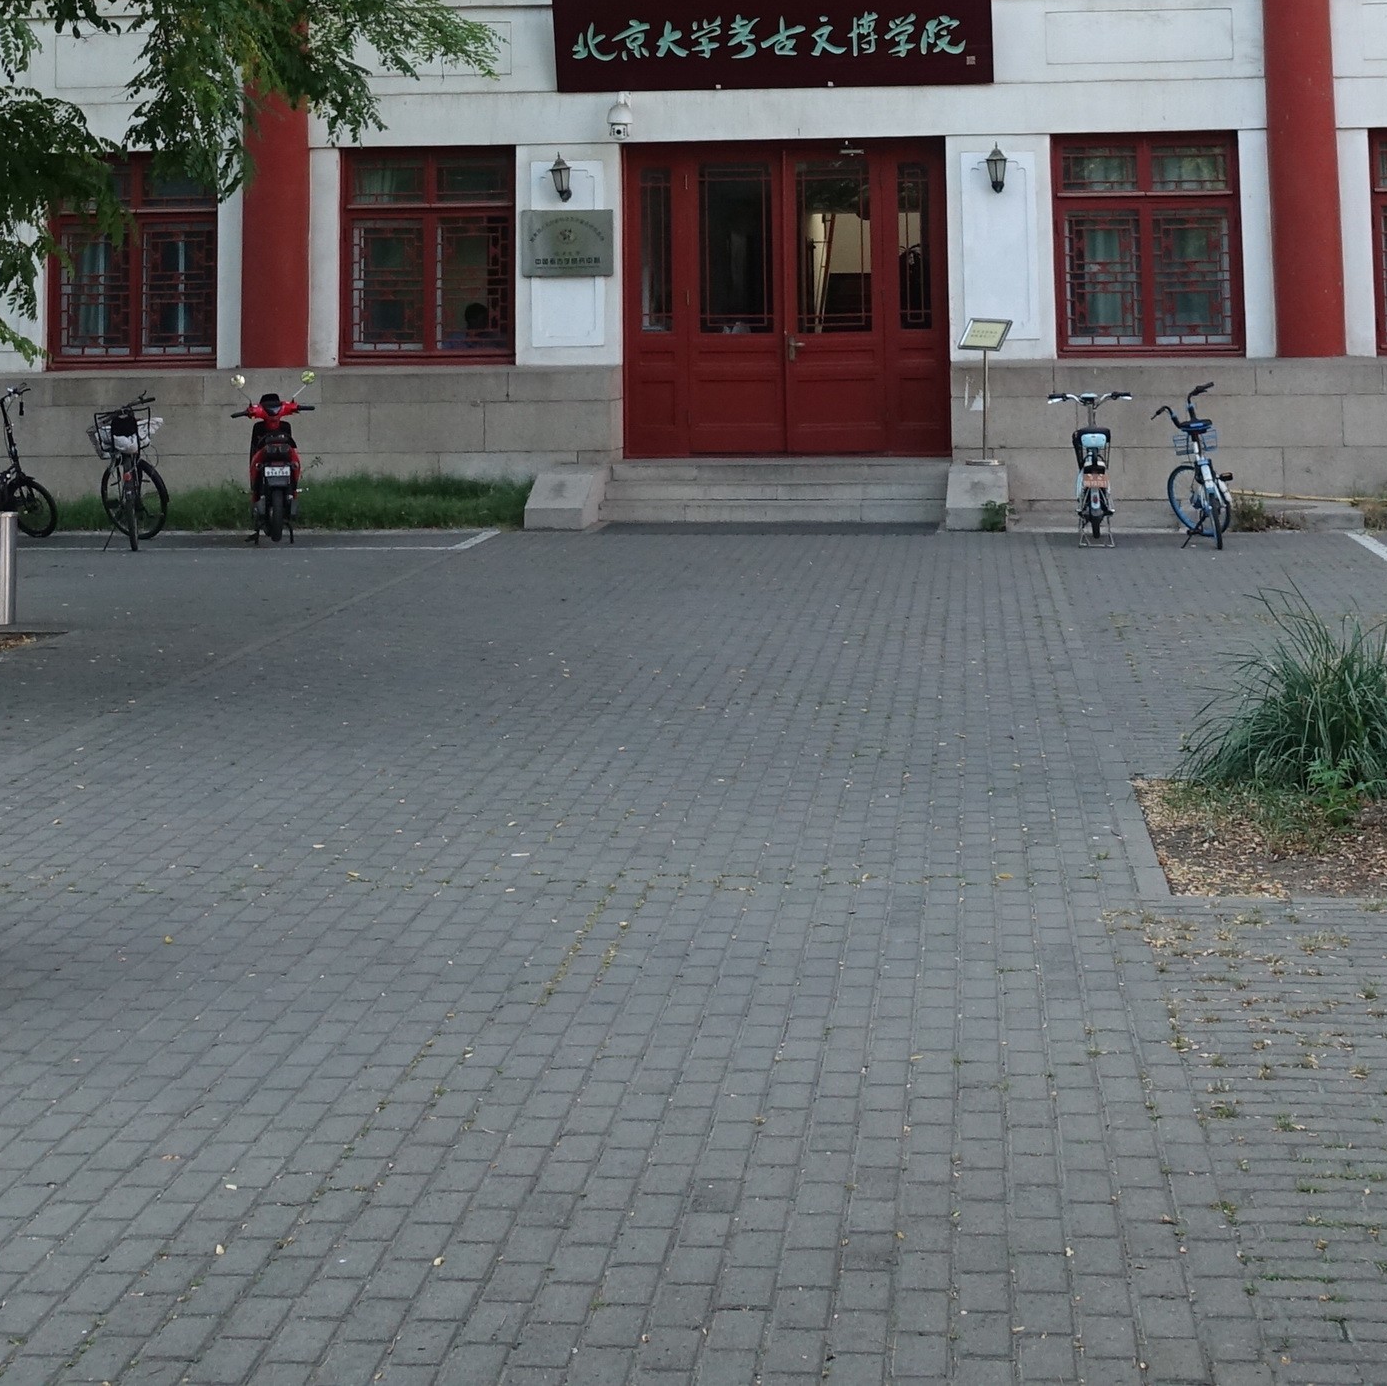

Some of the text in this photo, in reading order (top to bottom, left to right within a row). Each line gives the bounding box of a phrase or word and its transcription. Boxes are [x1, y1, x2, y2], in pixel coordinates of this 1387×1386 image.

[571, 10, 966, 61] 北京大学考古文博学院
